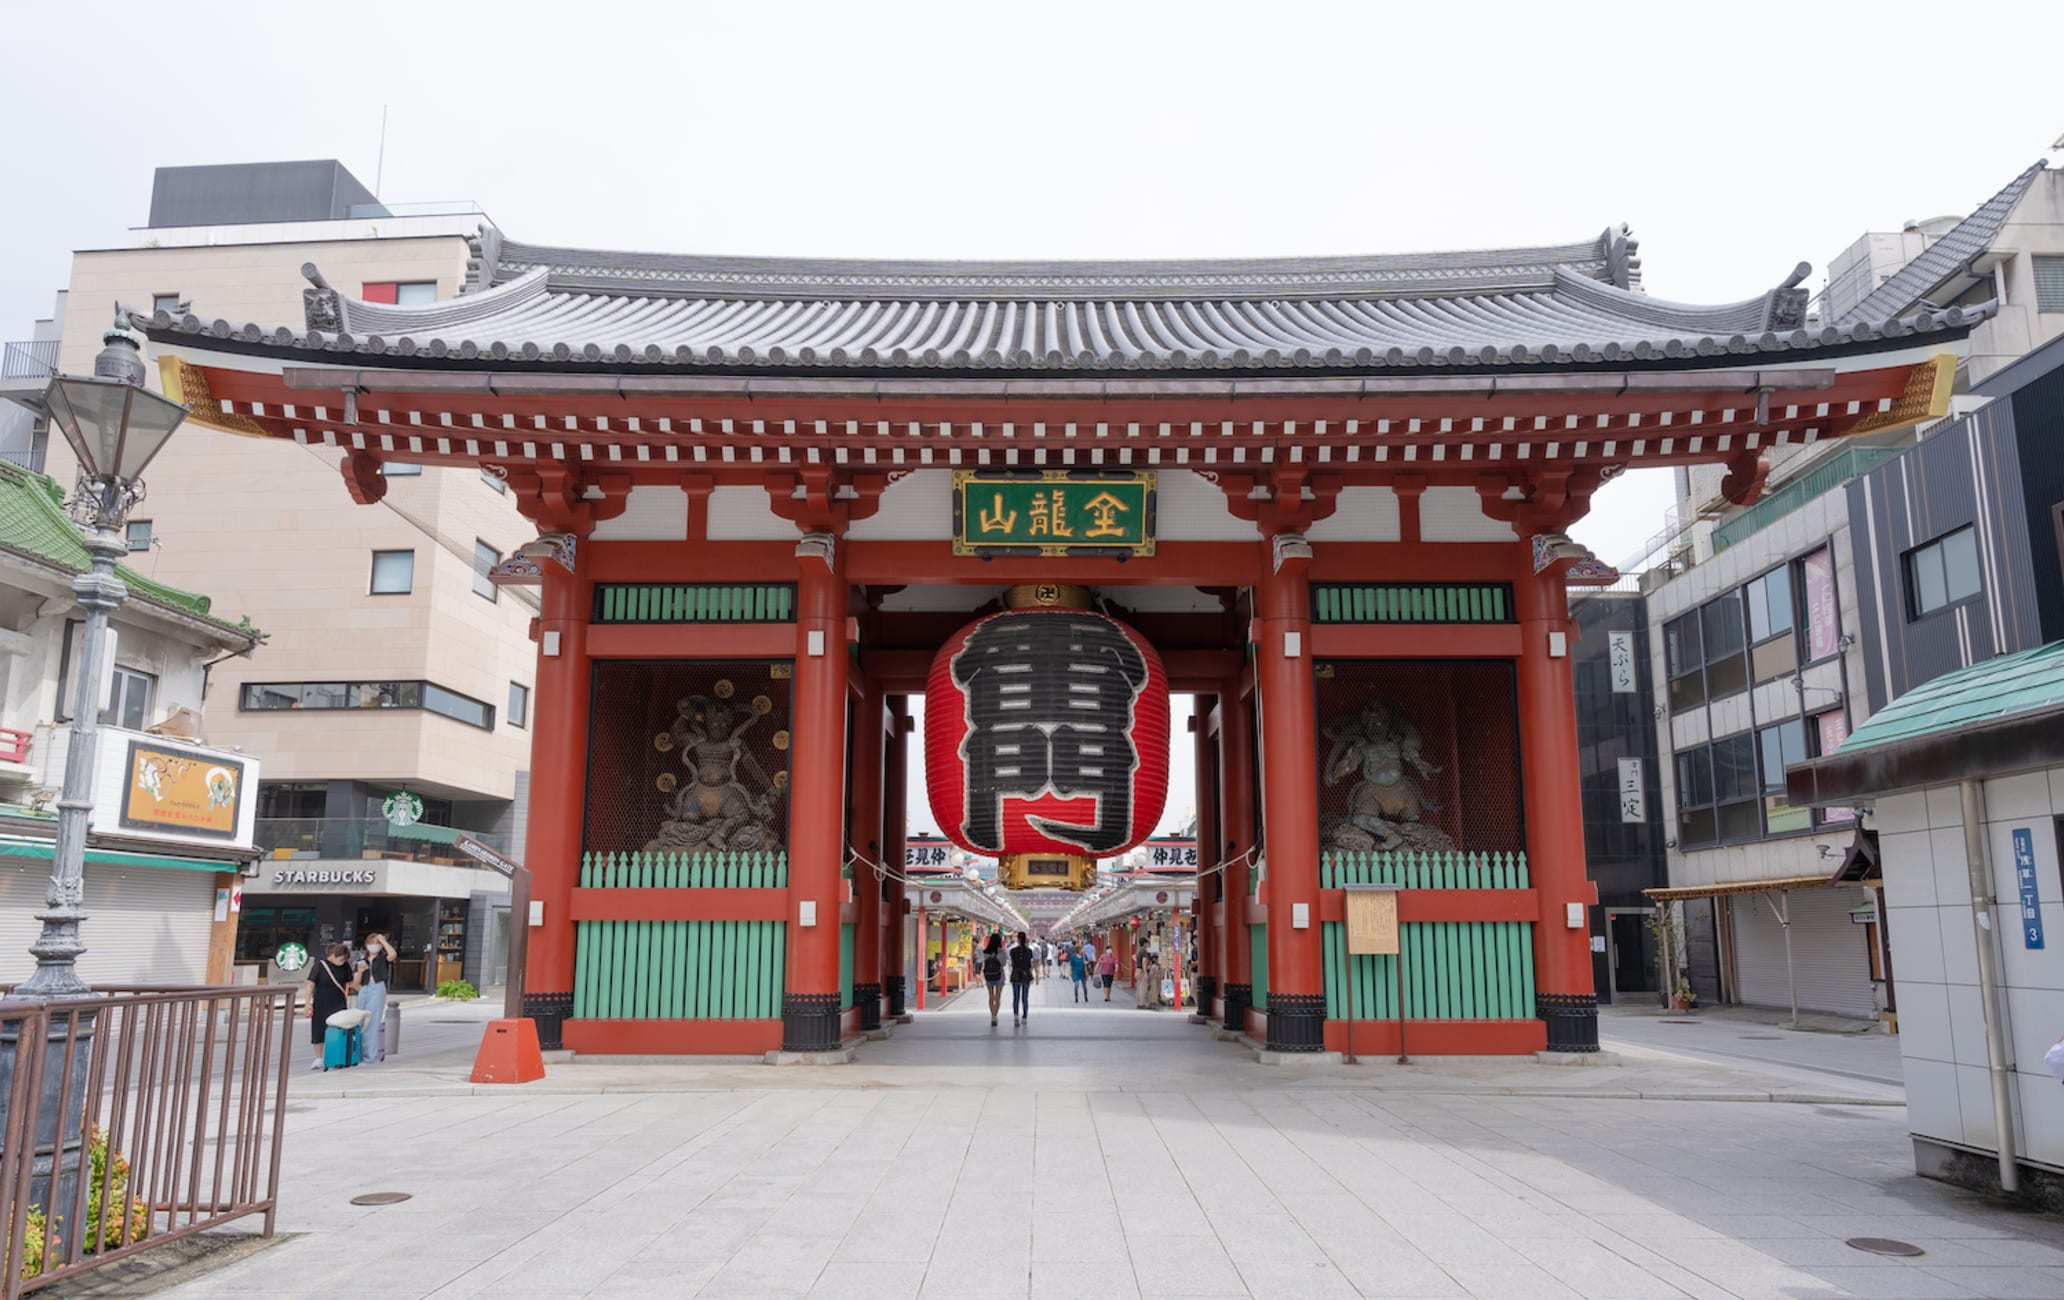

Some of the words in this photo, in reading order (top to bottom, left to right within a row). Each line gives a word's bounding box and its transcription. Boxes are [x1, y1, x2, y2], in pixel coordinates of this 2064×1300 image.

[1611, 637, 1630, 687] 天ぷら
[950, 611, 1148, 852] 雷門
[1622, 779, 1640, 818] 三定
[274, 870, 376, 884] STARBUCKS
[2029, 927, 2038, 942] 3
